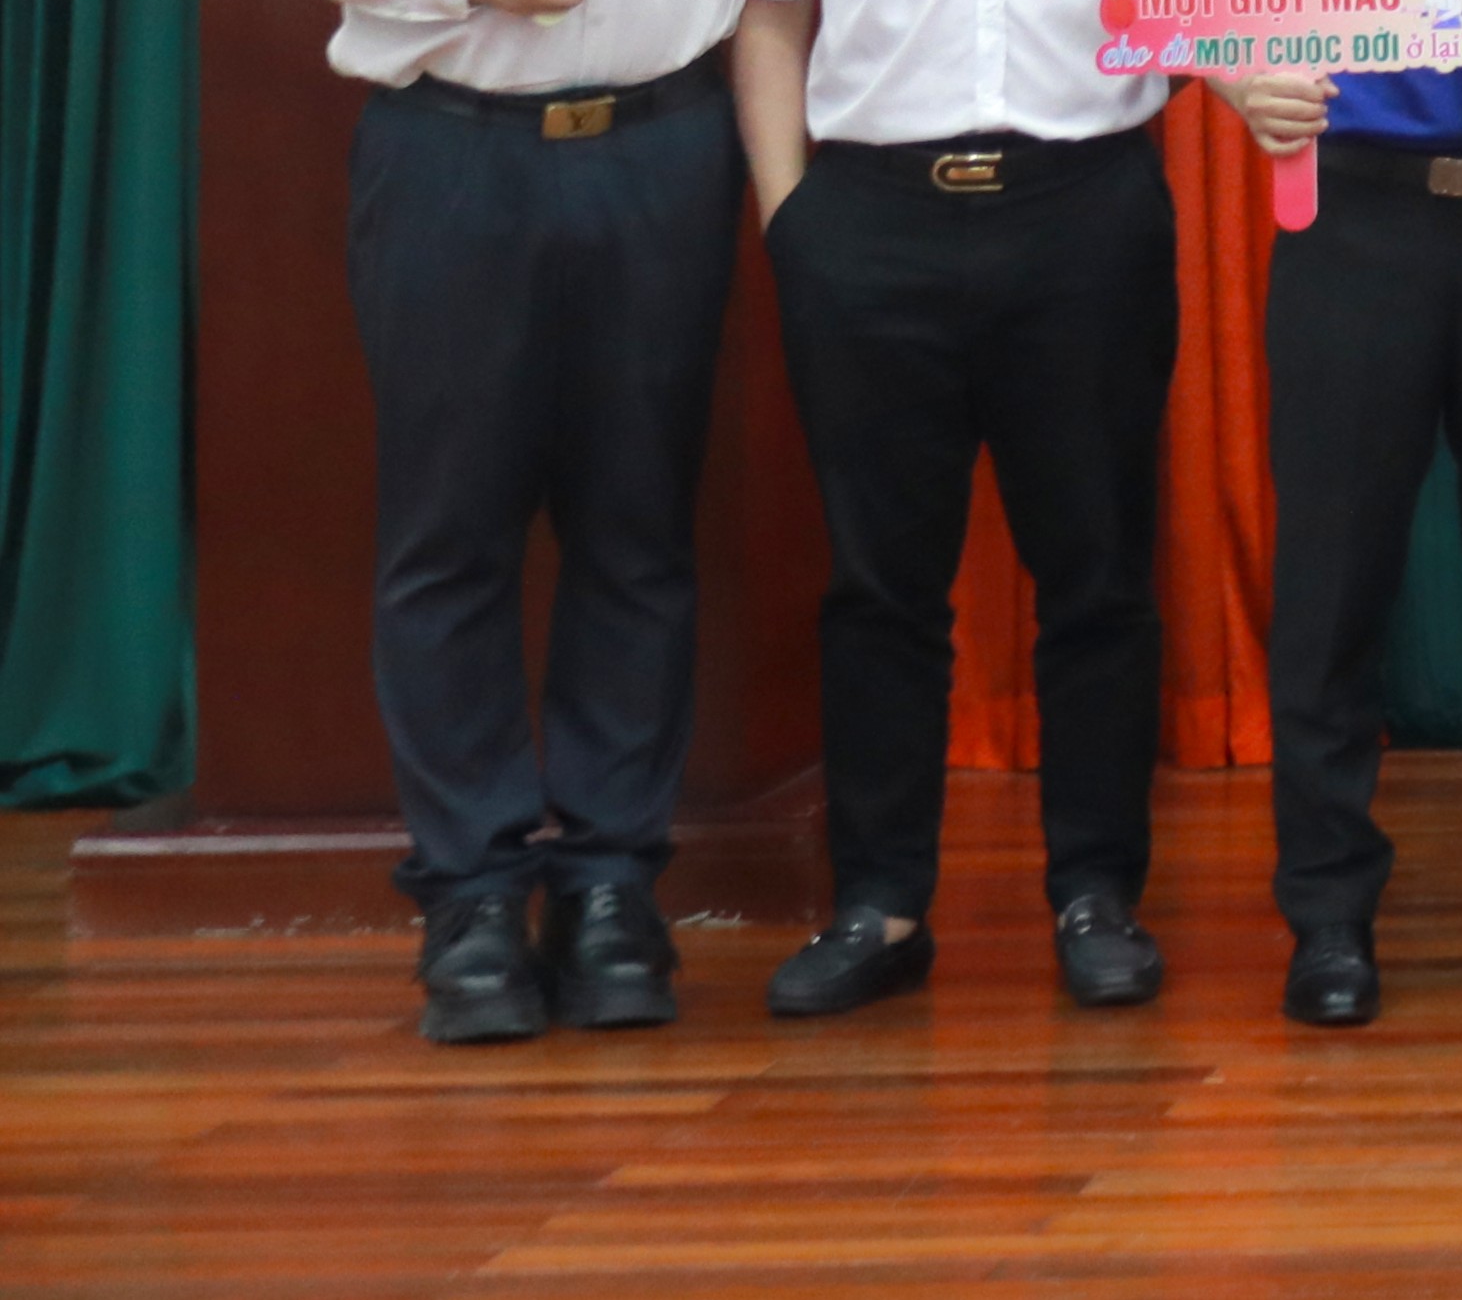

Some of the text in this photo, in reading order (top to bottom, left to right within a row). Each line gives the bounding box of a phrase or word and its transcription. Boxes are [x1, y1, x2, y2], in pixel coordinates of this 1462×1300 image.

[1102, 26, 1460, 72] cho đi MỘT CUỘC ĐỜI ở lại
